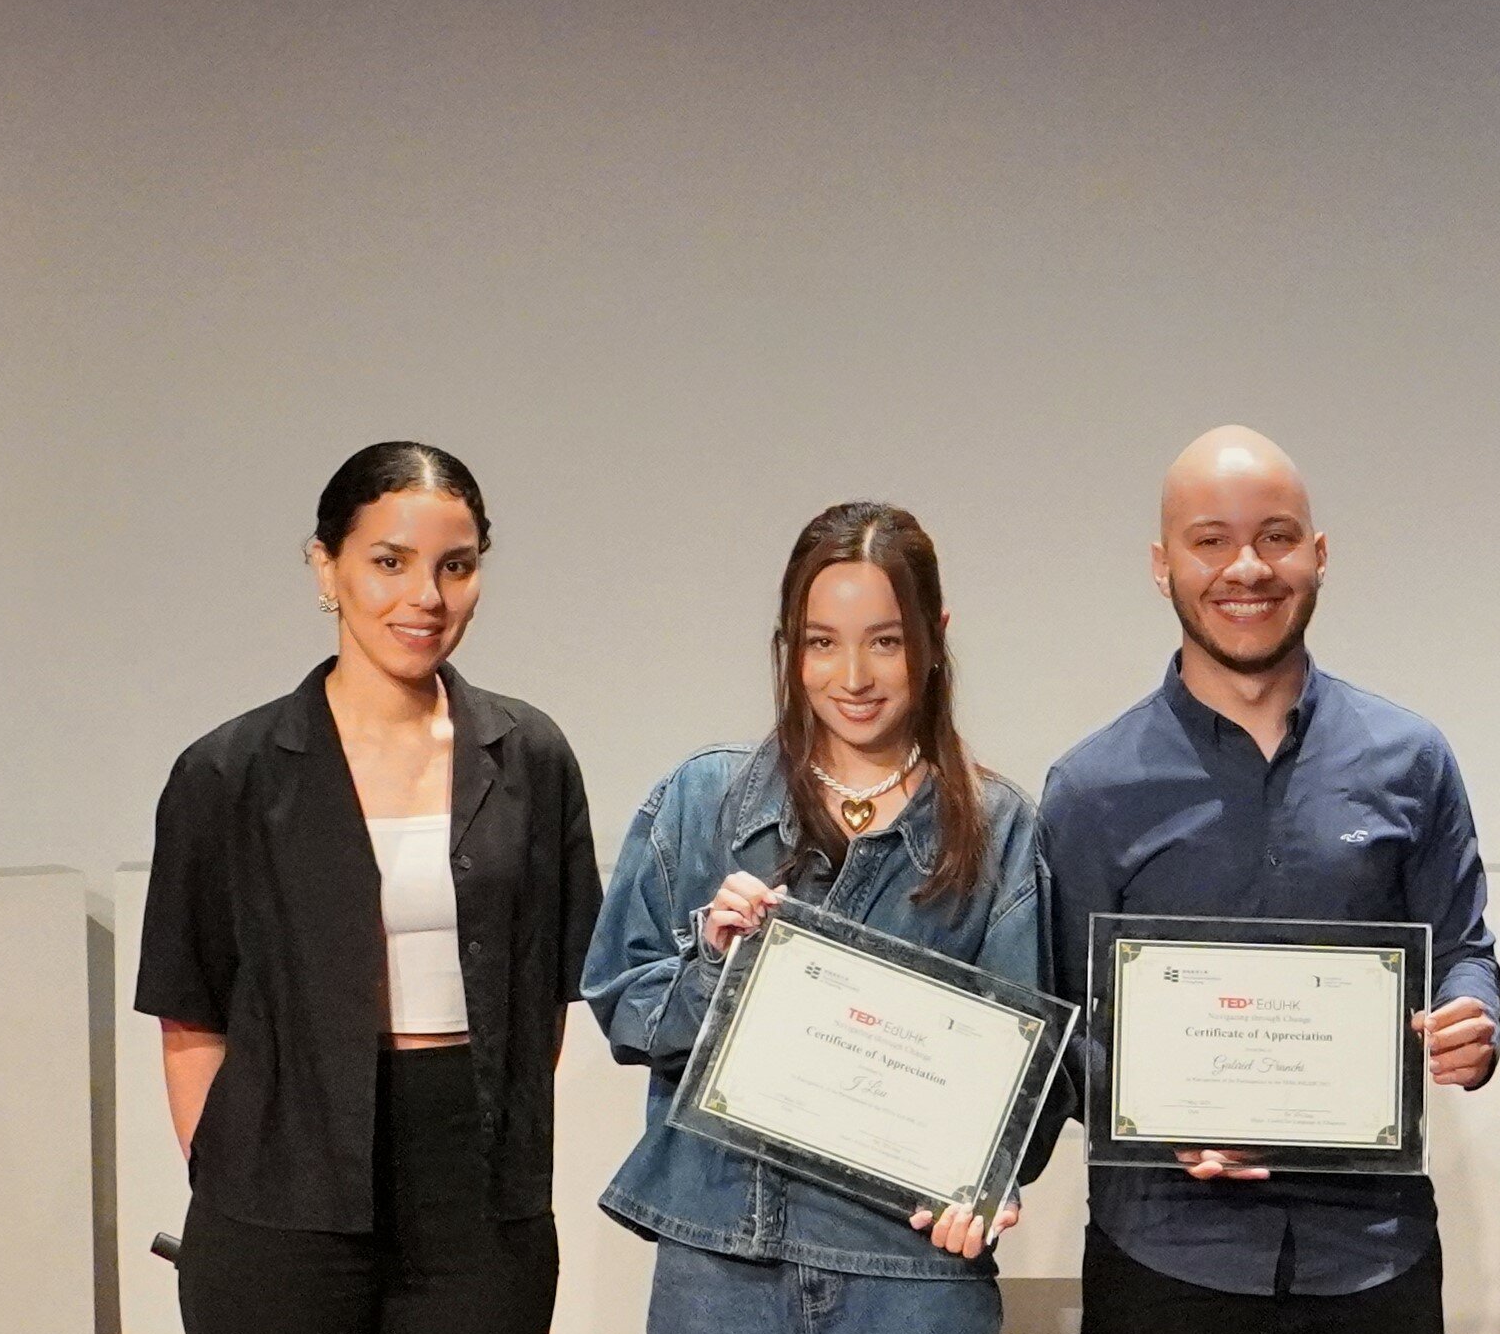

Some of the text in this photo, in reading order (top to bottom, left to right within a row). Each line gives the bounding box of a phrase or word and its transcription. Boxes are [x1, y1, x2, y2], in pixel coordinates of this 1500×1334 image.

[1219, 998, 1300, 1011] TEDx EdUHK
[849, 1007, 928, 1046] TEDx EdUHK
[1186, 1027, 1333, 1042] Certificate of Appreciation
[806, 1026, 863, 1054] Certificate
[866, 1050, 877, 1059] of
[881, 1054, 947, 1086] Appreciation
